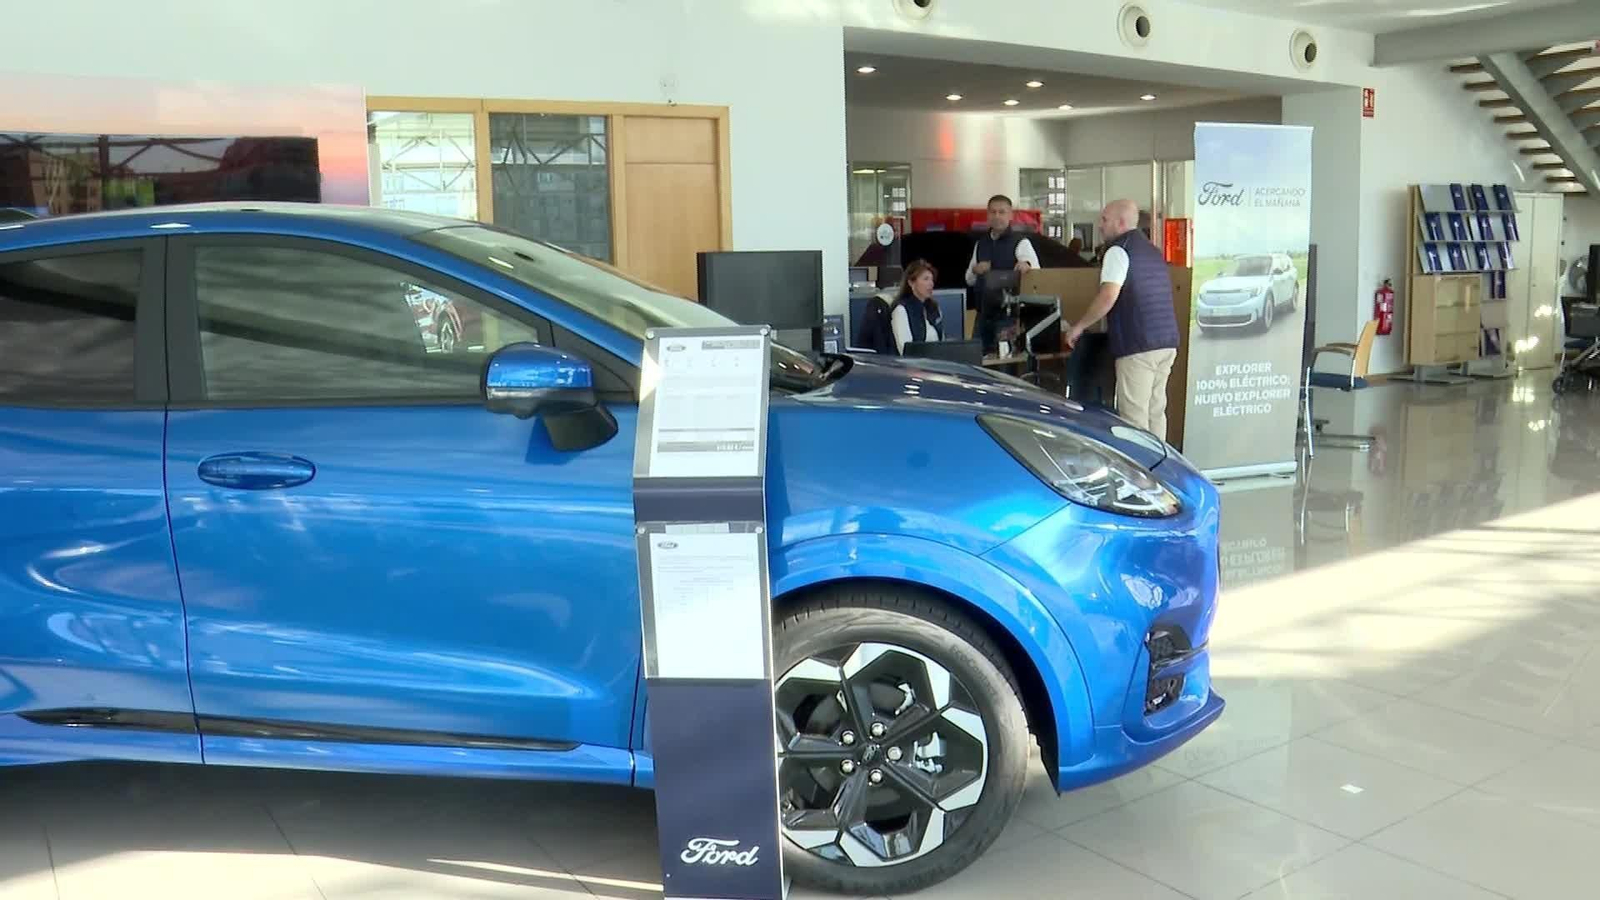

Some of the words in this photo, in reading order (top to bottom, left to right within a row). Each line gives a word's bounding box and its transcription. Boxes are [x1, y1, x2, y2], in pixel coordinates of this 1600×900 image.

[1199, 181, 1244, 206] Ford
[1254, 199, 1264, 207] EL
[1216, 362, 1272, 375] EXPLORER
[1196, 380, 1228, 391] 100%
[1195, 392, 1233, 405] NUEVO
[1234, 388, 1290, 402] EXPLORER
[1213, 403, 1272, 417] ELÉCTRICO
[680, 837, 759, 866] Ford
